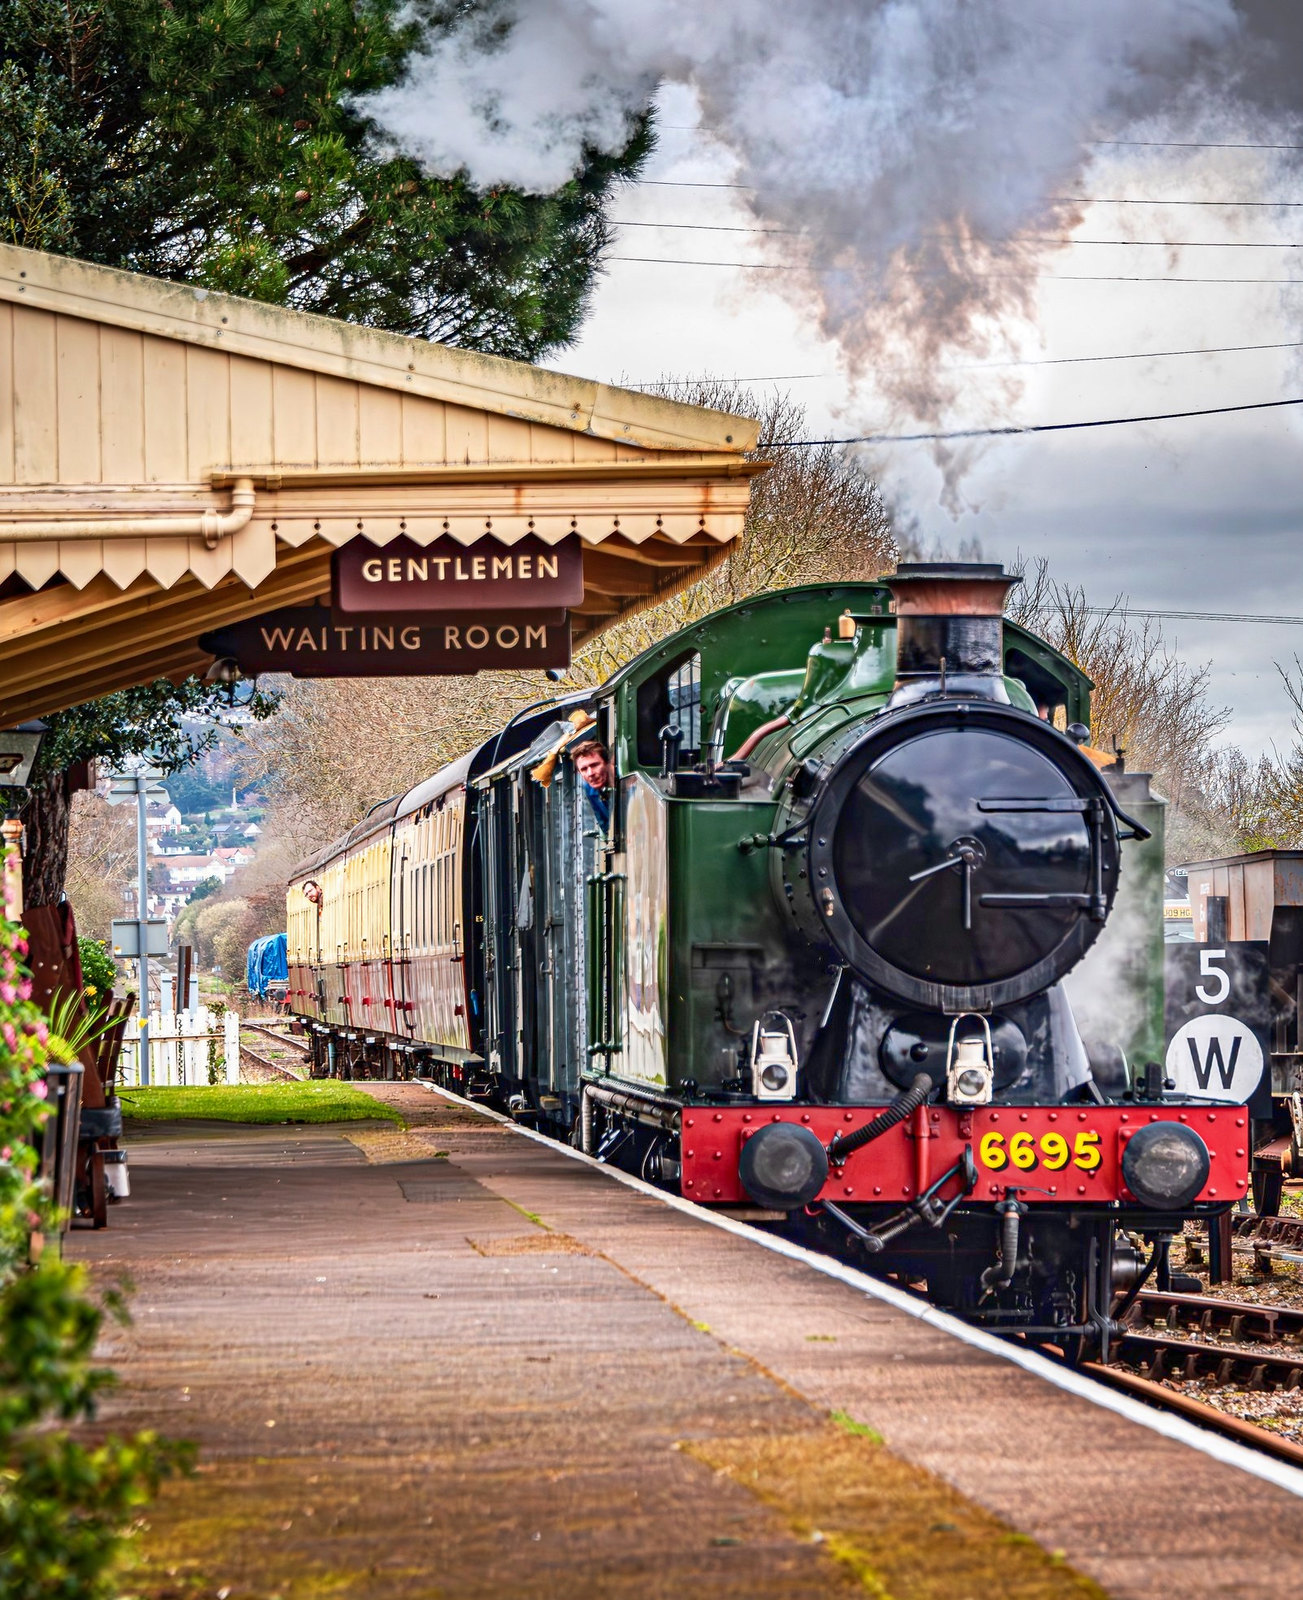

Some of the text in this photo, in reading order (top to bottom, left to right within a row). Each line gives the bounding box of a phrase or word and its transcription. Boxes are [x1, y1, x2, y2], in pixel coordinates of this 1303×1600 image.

[362, 555, 559, 582] GENTLEMEN
[260, 624, 547, 651] WAITING ROOM
[1195, 949, 1231, 1005] 5
[1186, 1036, 1243, 1090] W
[979, 1131, 1102, 1170] 6695
